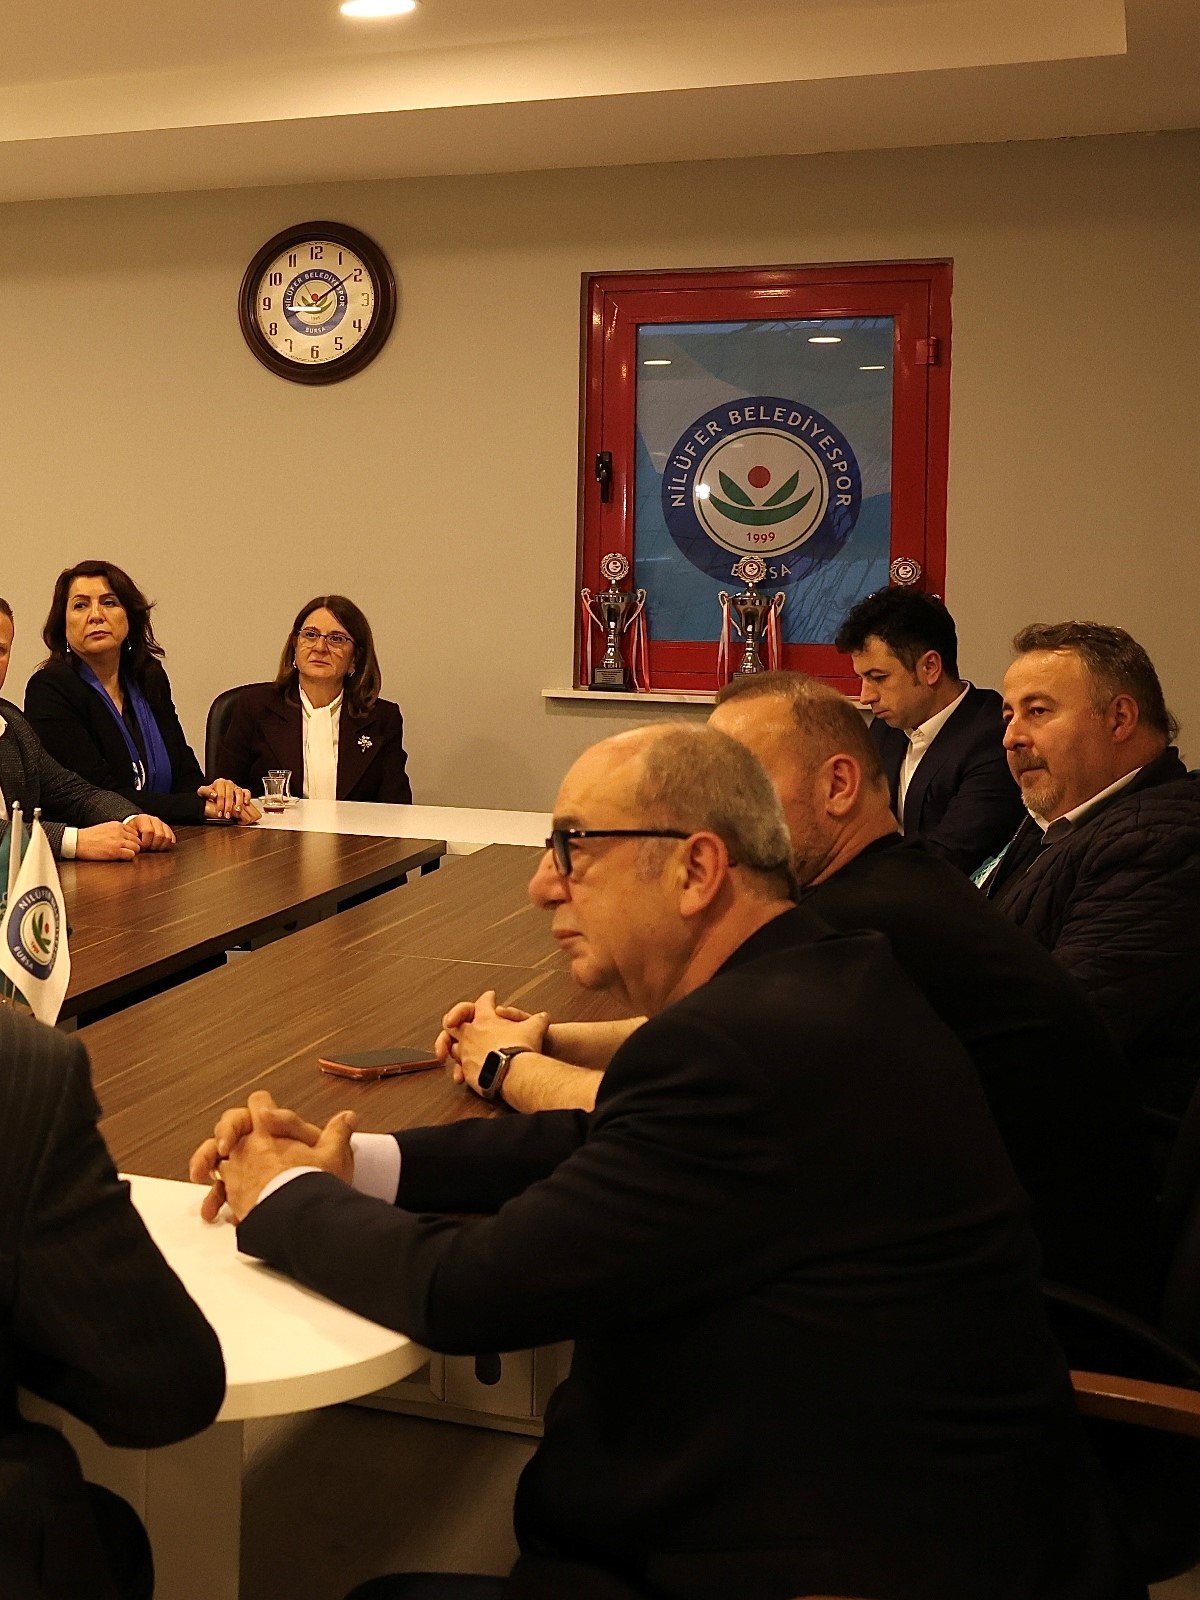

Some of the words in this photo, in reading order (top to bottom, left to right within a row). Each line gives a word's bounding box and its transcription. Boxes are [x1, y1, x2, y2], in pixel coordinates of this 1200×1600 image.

[288, 253, 297, 267] 11
[310, 246, 323, 260] 12
[338, 251, 343, 265] 1
[269, 272, 283, 286] 10
[353, 268, 363, 282] 2
[262, 297, 272, 311] 9
[361, 292, 370, 307] 3
[269, 322, 278, 336] 8
[352, 318, 362, 333] 4
[284, 338, 293, 352] 7
[334, 336, 343, 351] 5
[310, 345, 319, 359] 6
[667, 420, 722, 507] NİLÜFER
[728, 405, 851, 507] BELEDİYESPOR
[746, 531, 776, 544] 1999
[730, 563, 792, 579] BSA
